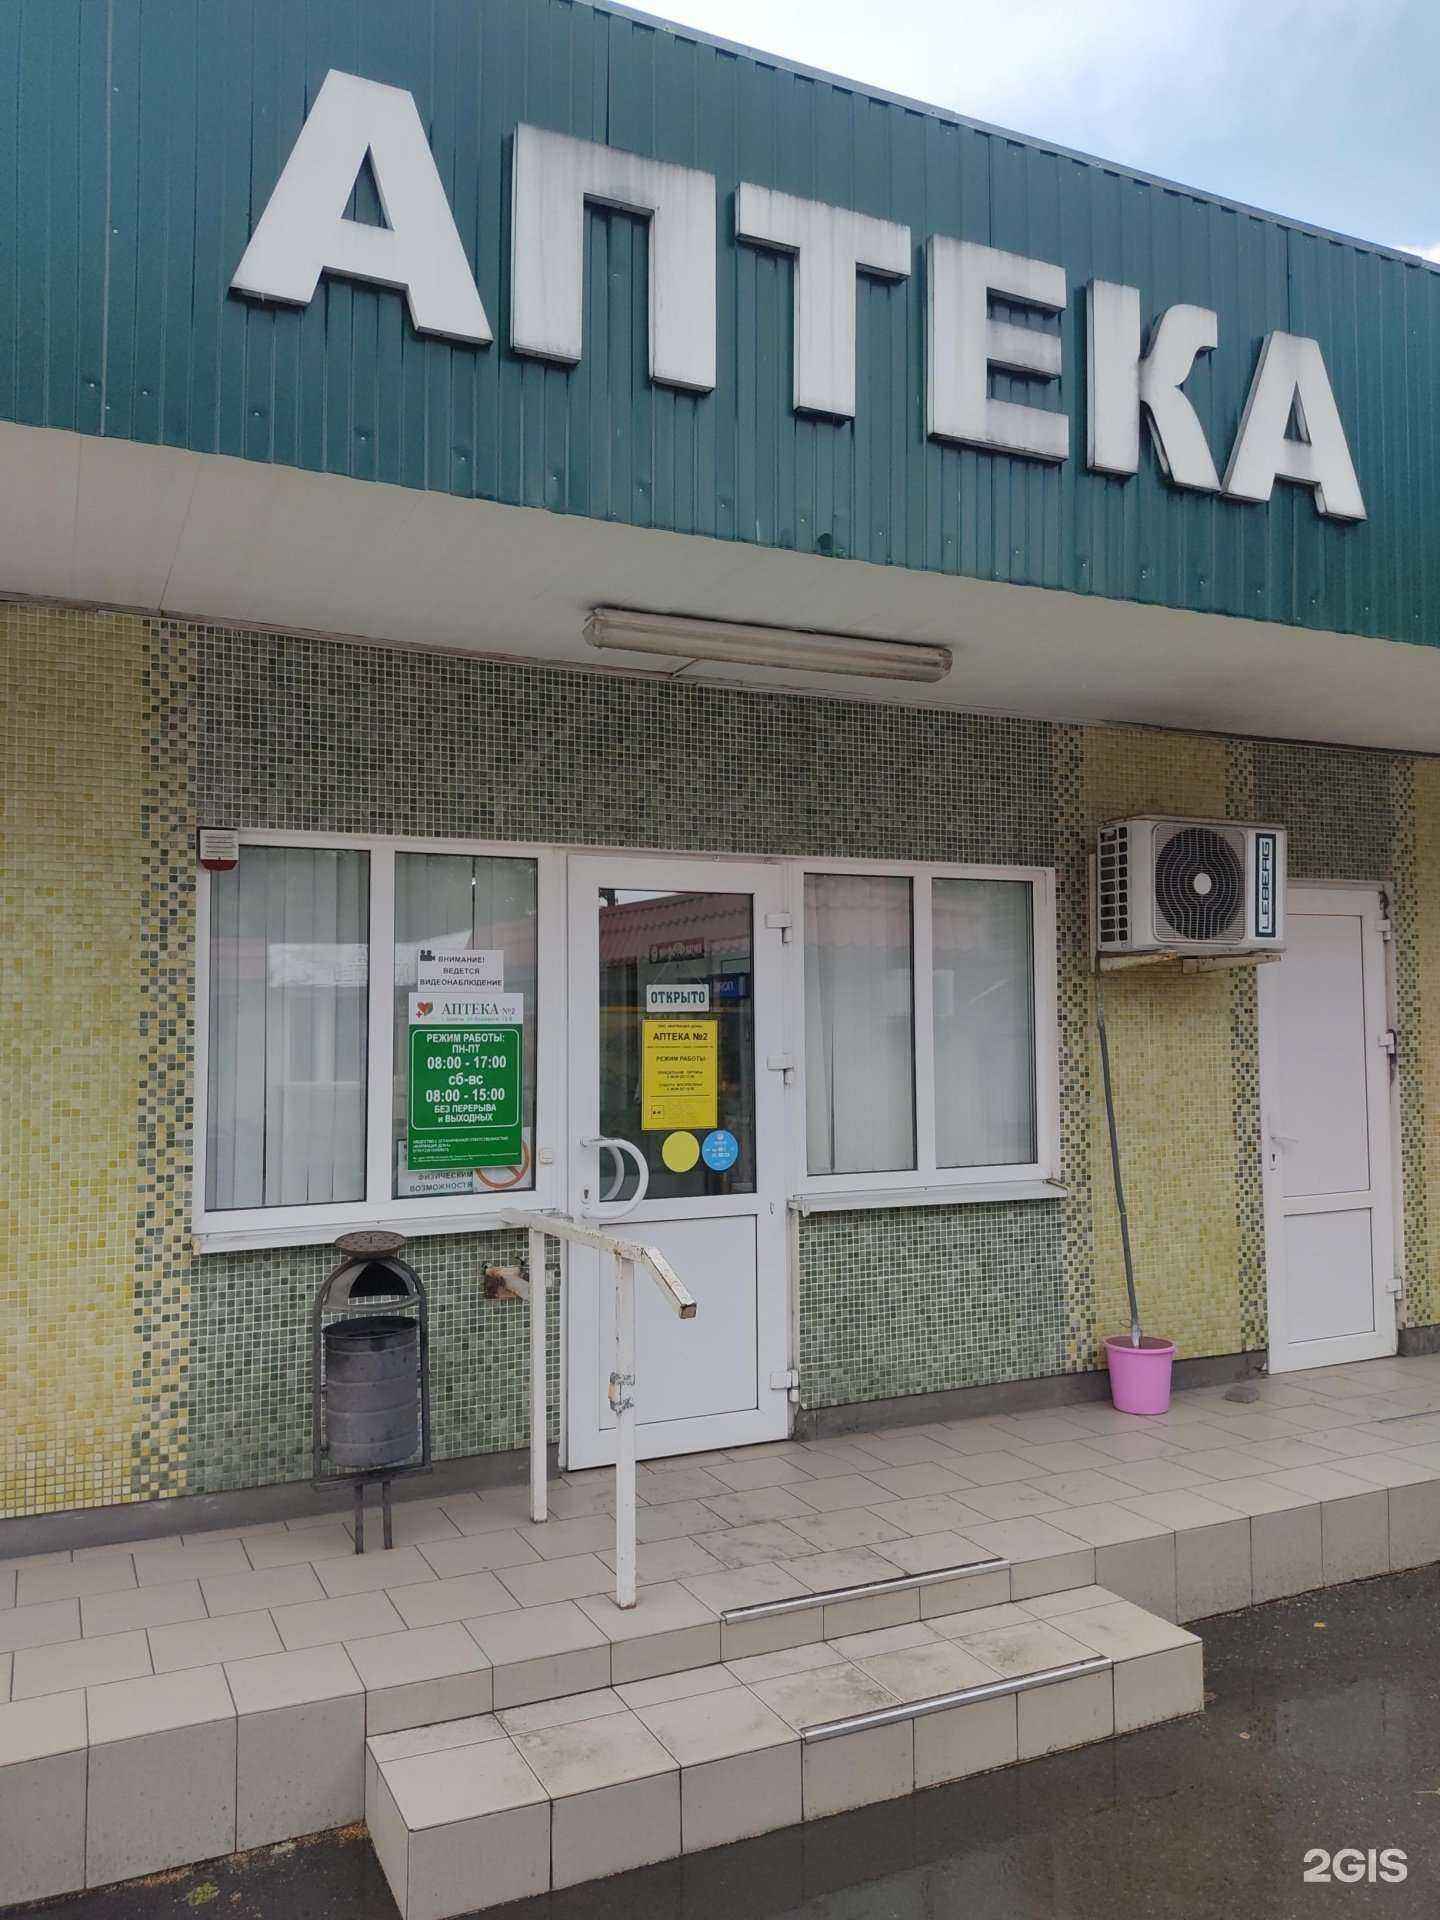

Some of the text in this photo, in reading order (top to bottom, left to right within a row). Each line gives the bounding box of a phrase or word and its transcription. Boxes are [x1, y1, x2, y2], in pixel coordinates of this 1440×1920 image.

[229, 68, 1367, 521] АПТЕКА
[1261, 841, 1270, 930] LEBERG
[438, 955, 485, 964] ВНИМАНИЕ!
[443, 967, 480, 976] ВЕДЕТСЯ
[419, 978, 503, 987] ВИДЕОНАБЛЮДЕНИЕ
[650, 990, 706, 1005] ОТКРЫТО
[441, 1001, 499, 1016] АПТЕКА
[426, 1032, 505, 1043] РЕЖИМ РАБОТЫ:
[653, 1032, 709, 1041] АПТЕКА №2
[452, 1044, 480, 1054] ПН-ПТ
[427, 1056, 462, 1070] 08:00
[473, 1055, 506, 1069] 17:00
[425, 1089, 460, 1103] 08:00
[472, 1088, 505, 1101] 15:00
[434, 1104, 497, 1114] БЕЗ ПЕРЕРЫВА
[445, 1113, 493, 1123] ВЫХОДНЫХ
